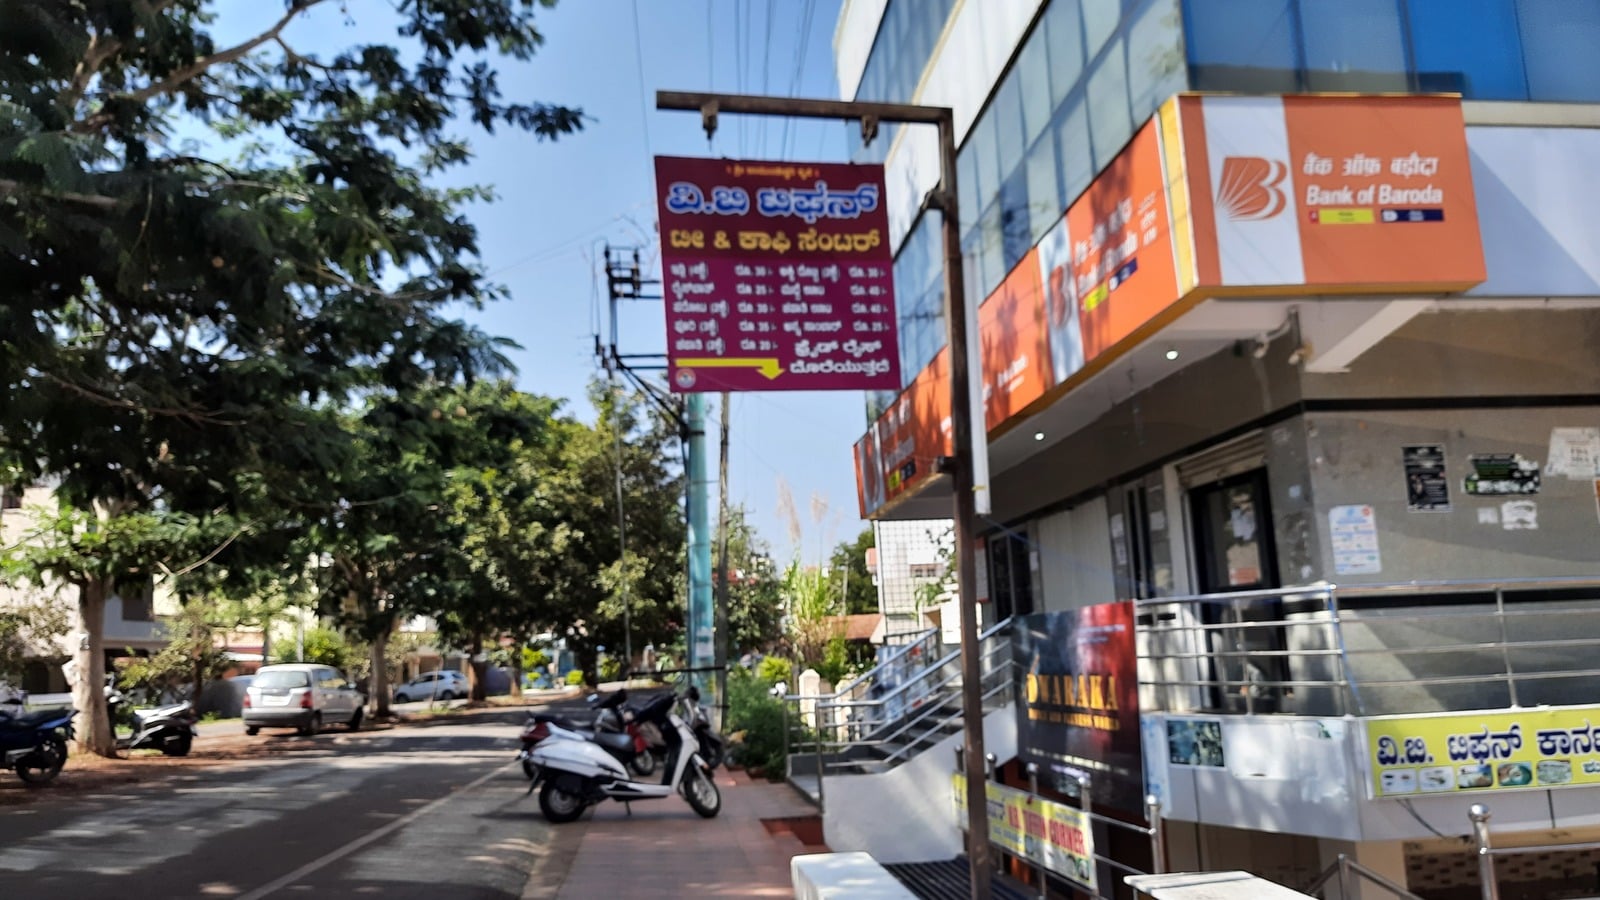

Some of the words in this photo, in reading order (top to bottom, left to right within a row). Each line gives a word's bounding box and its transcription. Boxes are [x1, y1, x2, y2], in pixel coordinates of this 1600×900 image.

[1306, 184, 1353, 205] Bank
[1357, 184, 1375, 203] of
[1378, 184, 1443, 204] Baroda
[714, 231, 731, 249] &
